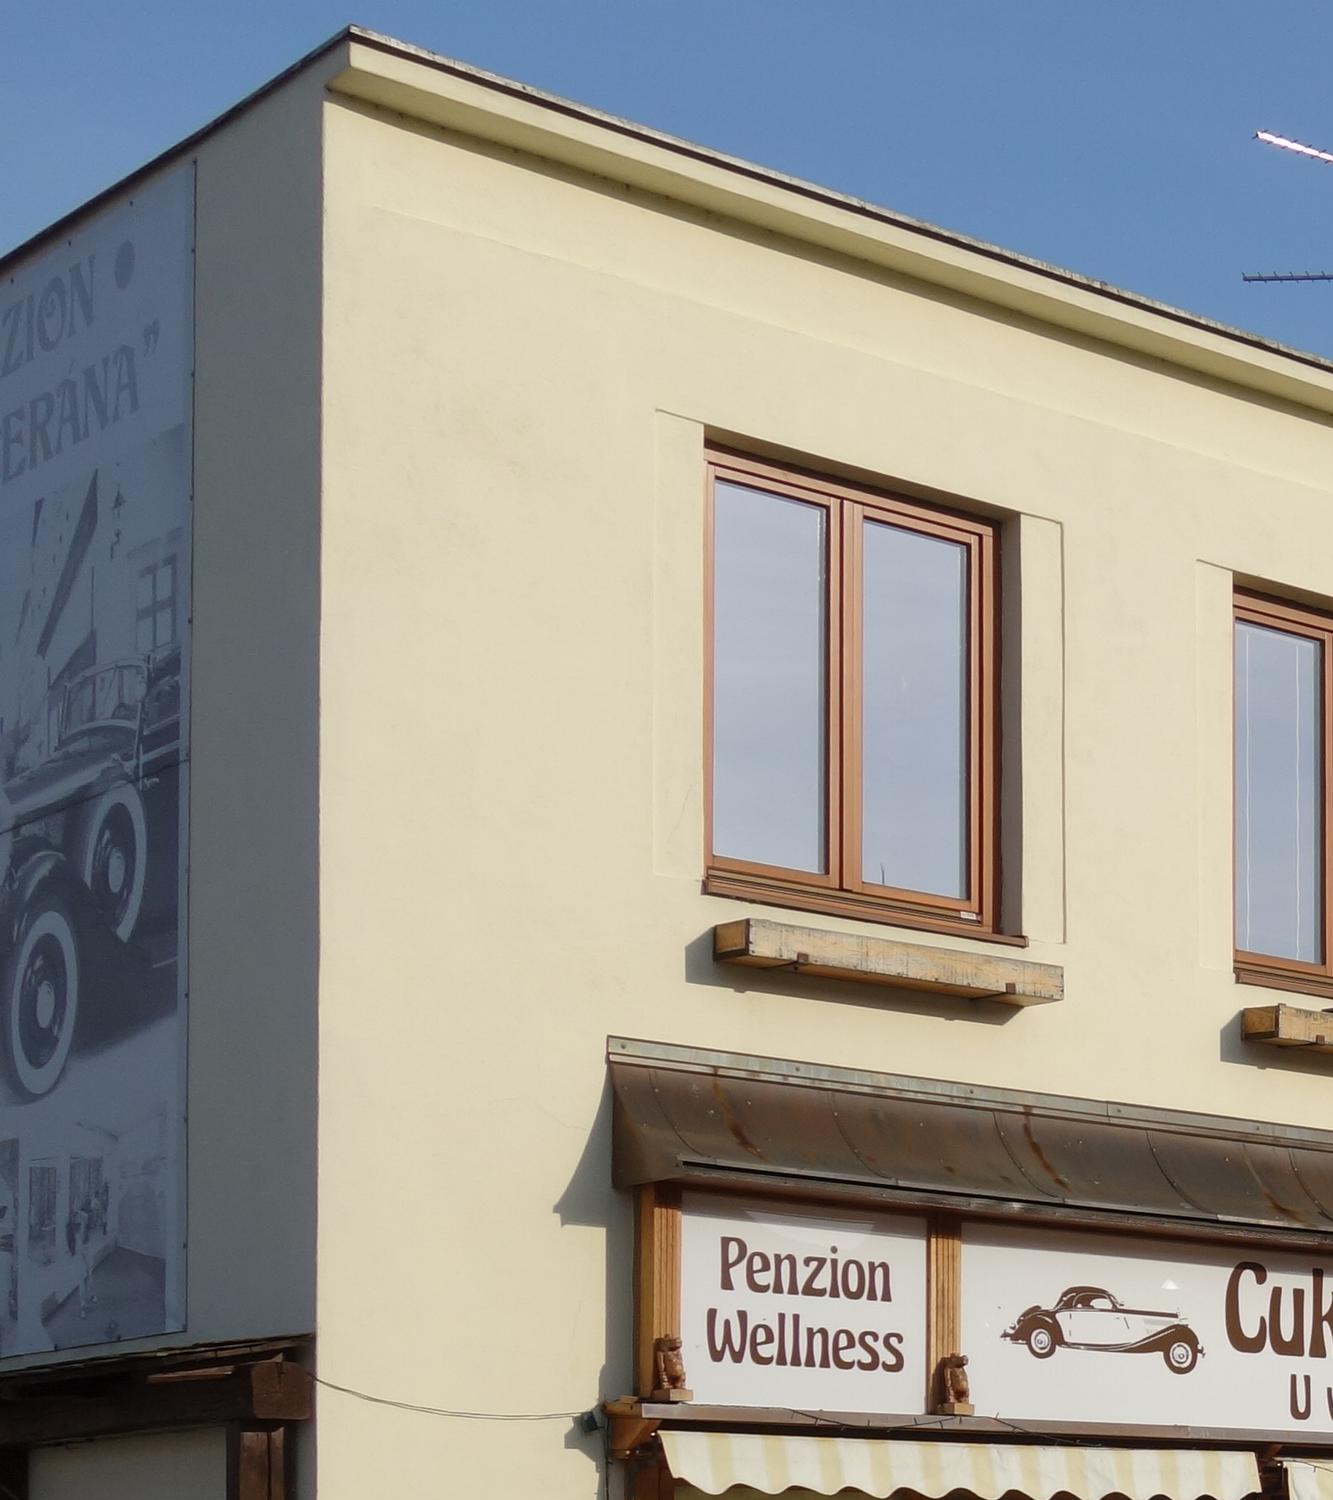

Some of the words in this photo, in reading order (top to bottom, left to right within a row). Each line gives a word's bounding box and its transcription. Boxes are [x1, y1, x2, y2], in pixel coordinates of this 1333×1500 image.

[719, 1235, 893, 1303] Penzion
[706, 1308, 904, 1374] Wellness
[1290, 1374, 1312, 1421] U
